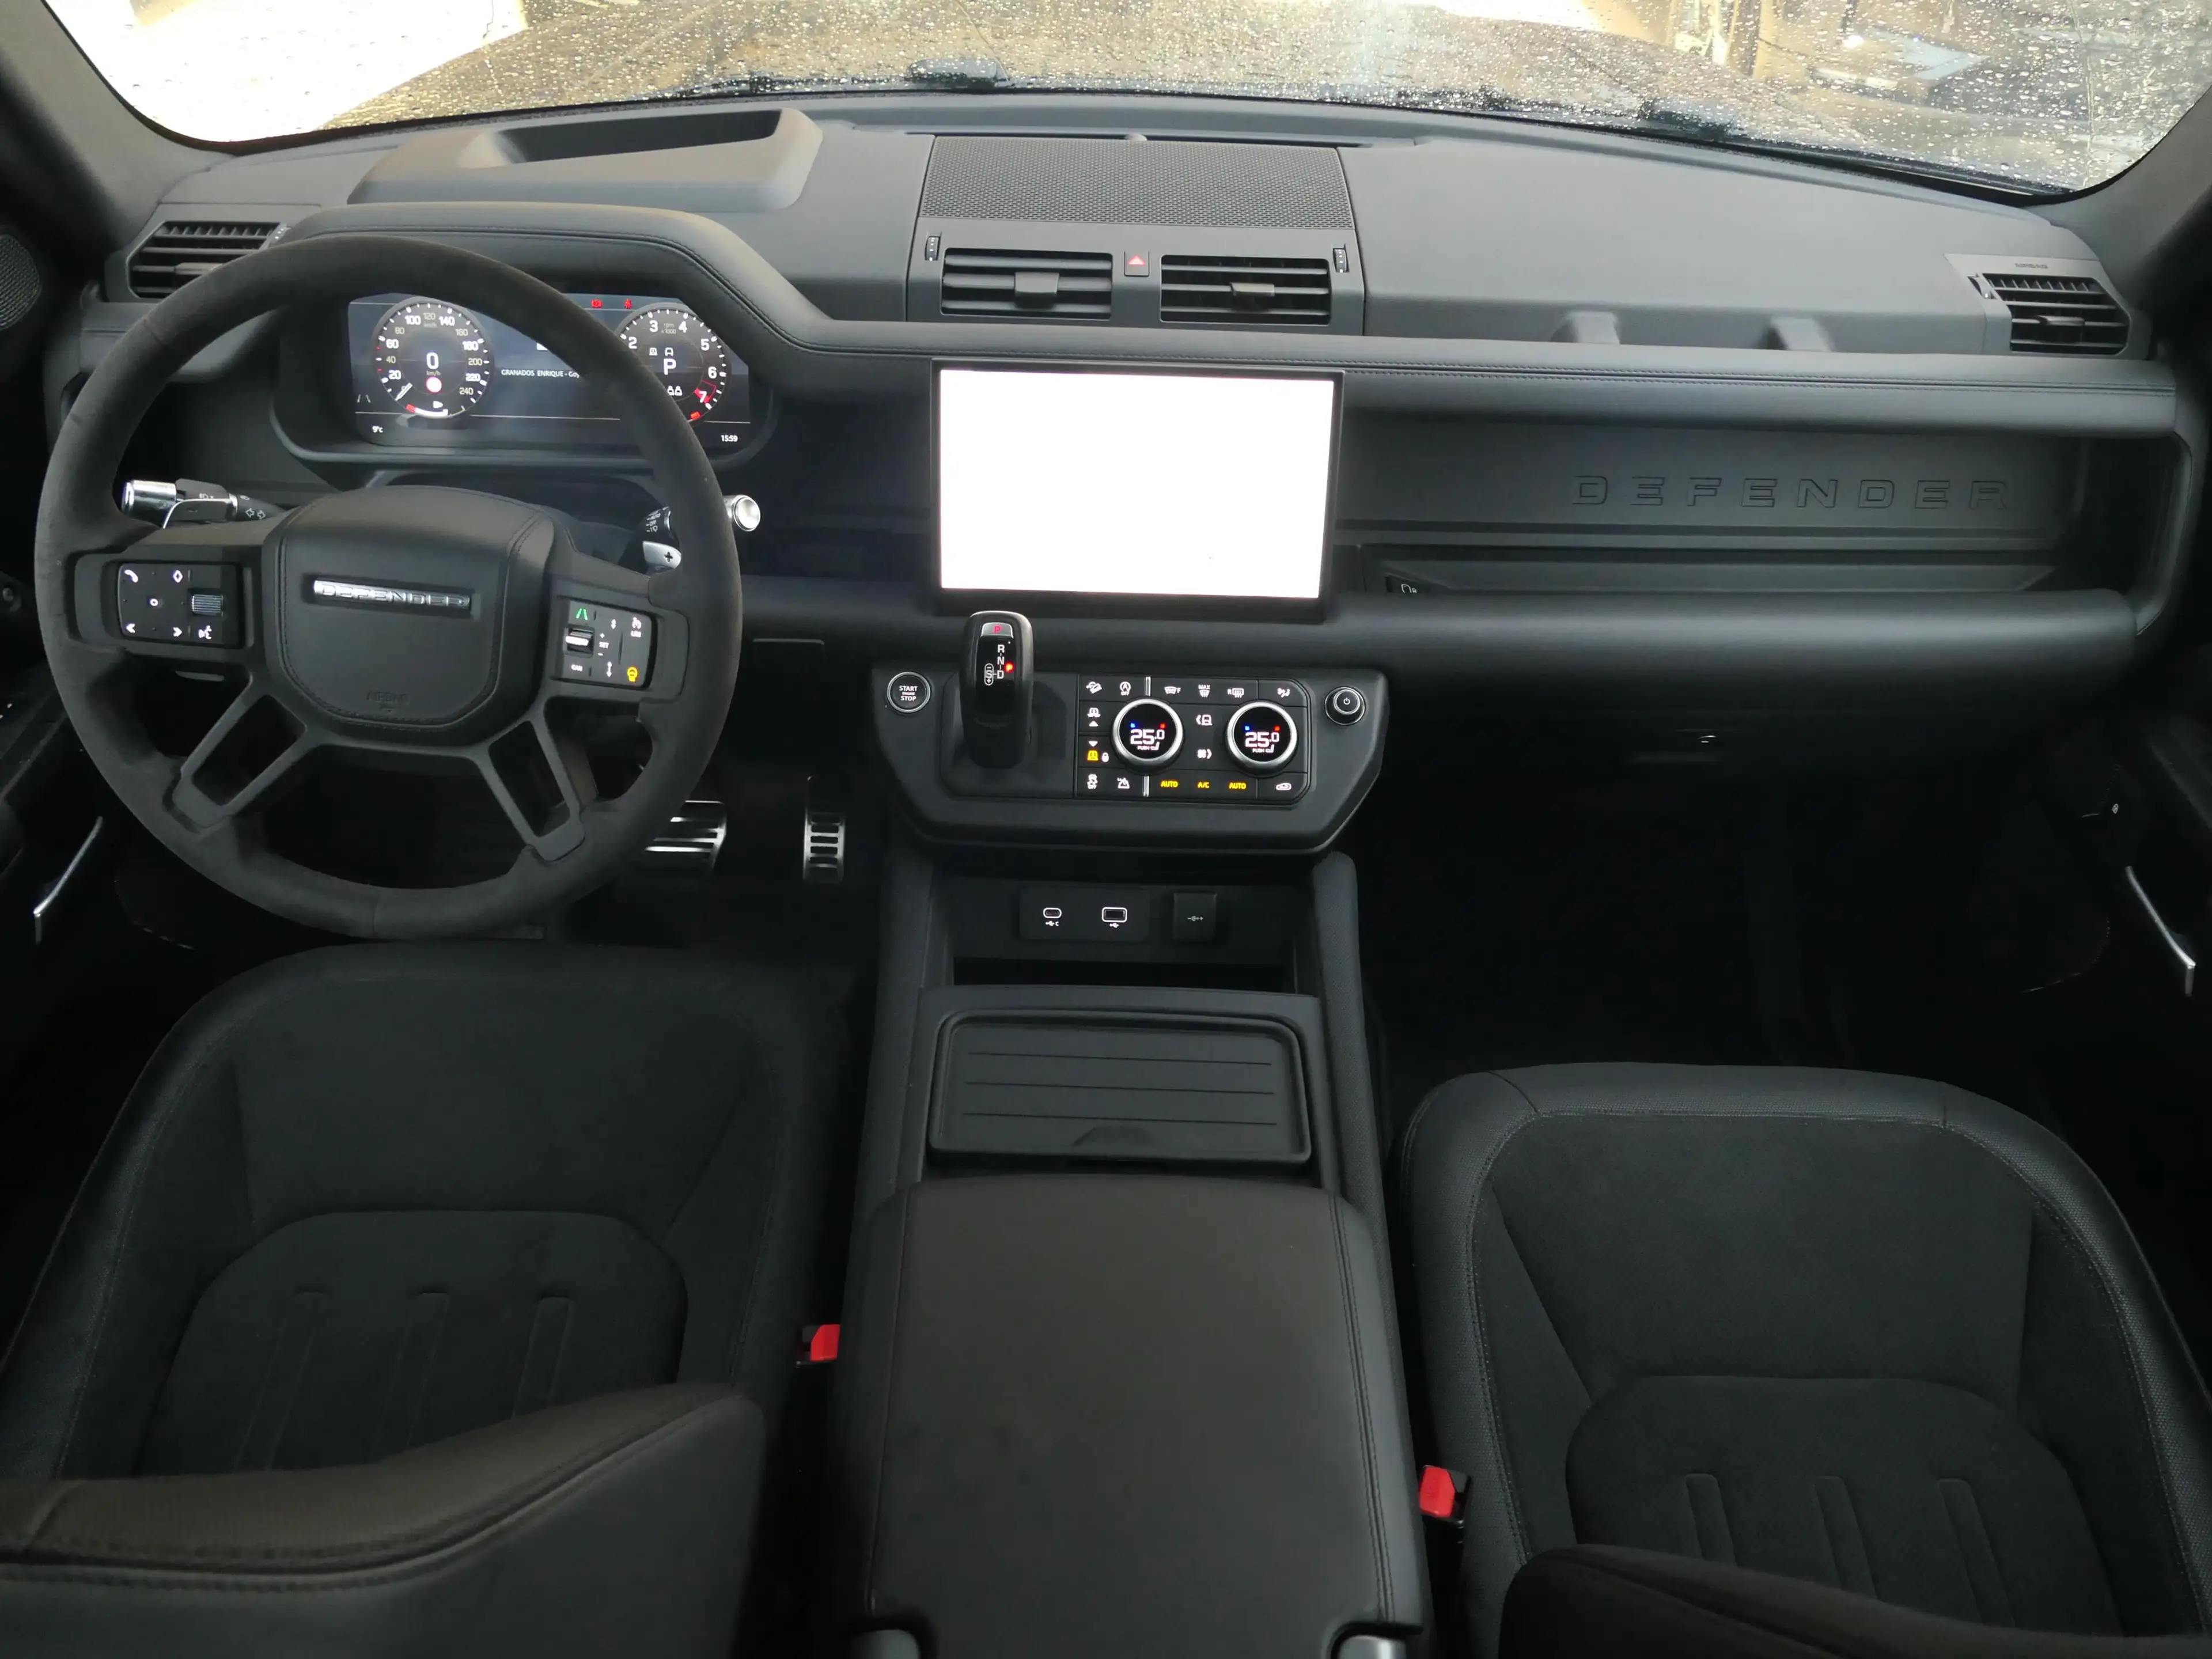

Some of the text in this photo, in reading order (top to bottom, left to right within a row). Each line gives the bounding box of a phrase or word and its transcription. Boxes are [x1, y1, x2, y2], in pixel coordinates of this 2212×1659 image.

[404, 315, 421, 325] 100
[438, 316, 455, 326] 140
[649, 320, 658, 332] 3
[679, 321, 687, 333] 4
[385, 339, 399, 349] 60
[462, 340, 479, 351] 180
[628, 336, 637, 349] 2
[700, 338, 710, 351] 5
[386, 355, 396, 363] 40
[426, 352, 439, 369] 0
[468, 358, 482, 366] 200
[664, 358, 676, 375] P
[388, 370, 402, 380] 20
[465, 373, 481, 381] 220
[537, 370, 563, 378] ENRIQUE
[708, 366, 717, 378] 6
[459, 387, 474, 395] 240
[699, 391, 707, 403] 7
[1571, 475, 2008, 510] DEFENDER
[314, 580, 470, 608] DEFENDER
[993, 624, 1002, 632] P
[997, 645, 1005, 653] R
[997, 657, 1005, 665] N
[986, 670, 993, 679] S
[997, 670, 1004, 679] D
[1130, 729, 1165, 745] 25.0
[1245, 732, 1279, 747] 25.0
